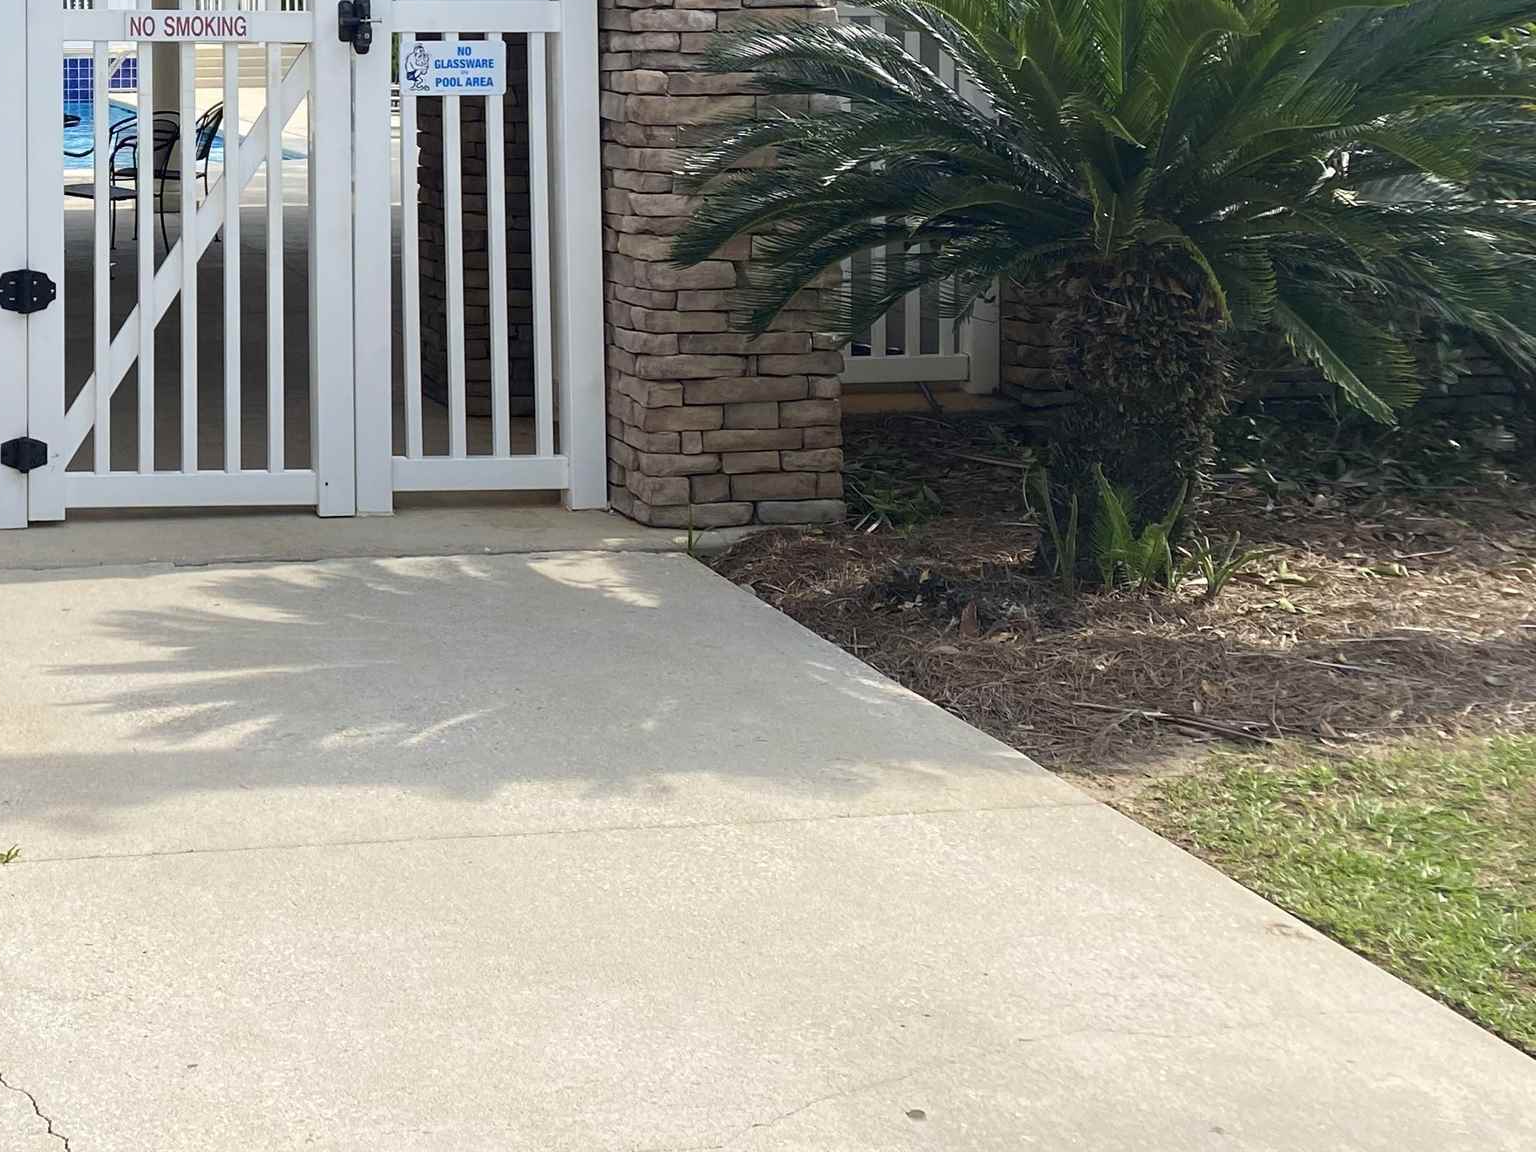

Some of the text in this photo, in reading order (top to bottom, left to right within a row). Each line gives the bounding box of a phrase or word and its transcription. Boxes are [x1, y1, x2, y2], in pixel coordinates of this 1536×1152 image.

[130, 16, 247, 37] NO SMOKING
[457, 46, 472, 56] NO
[434, 59, 494, 69] GLASSWARE
[435, 77, 494, 87] POOL AREA
